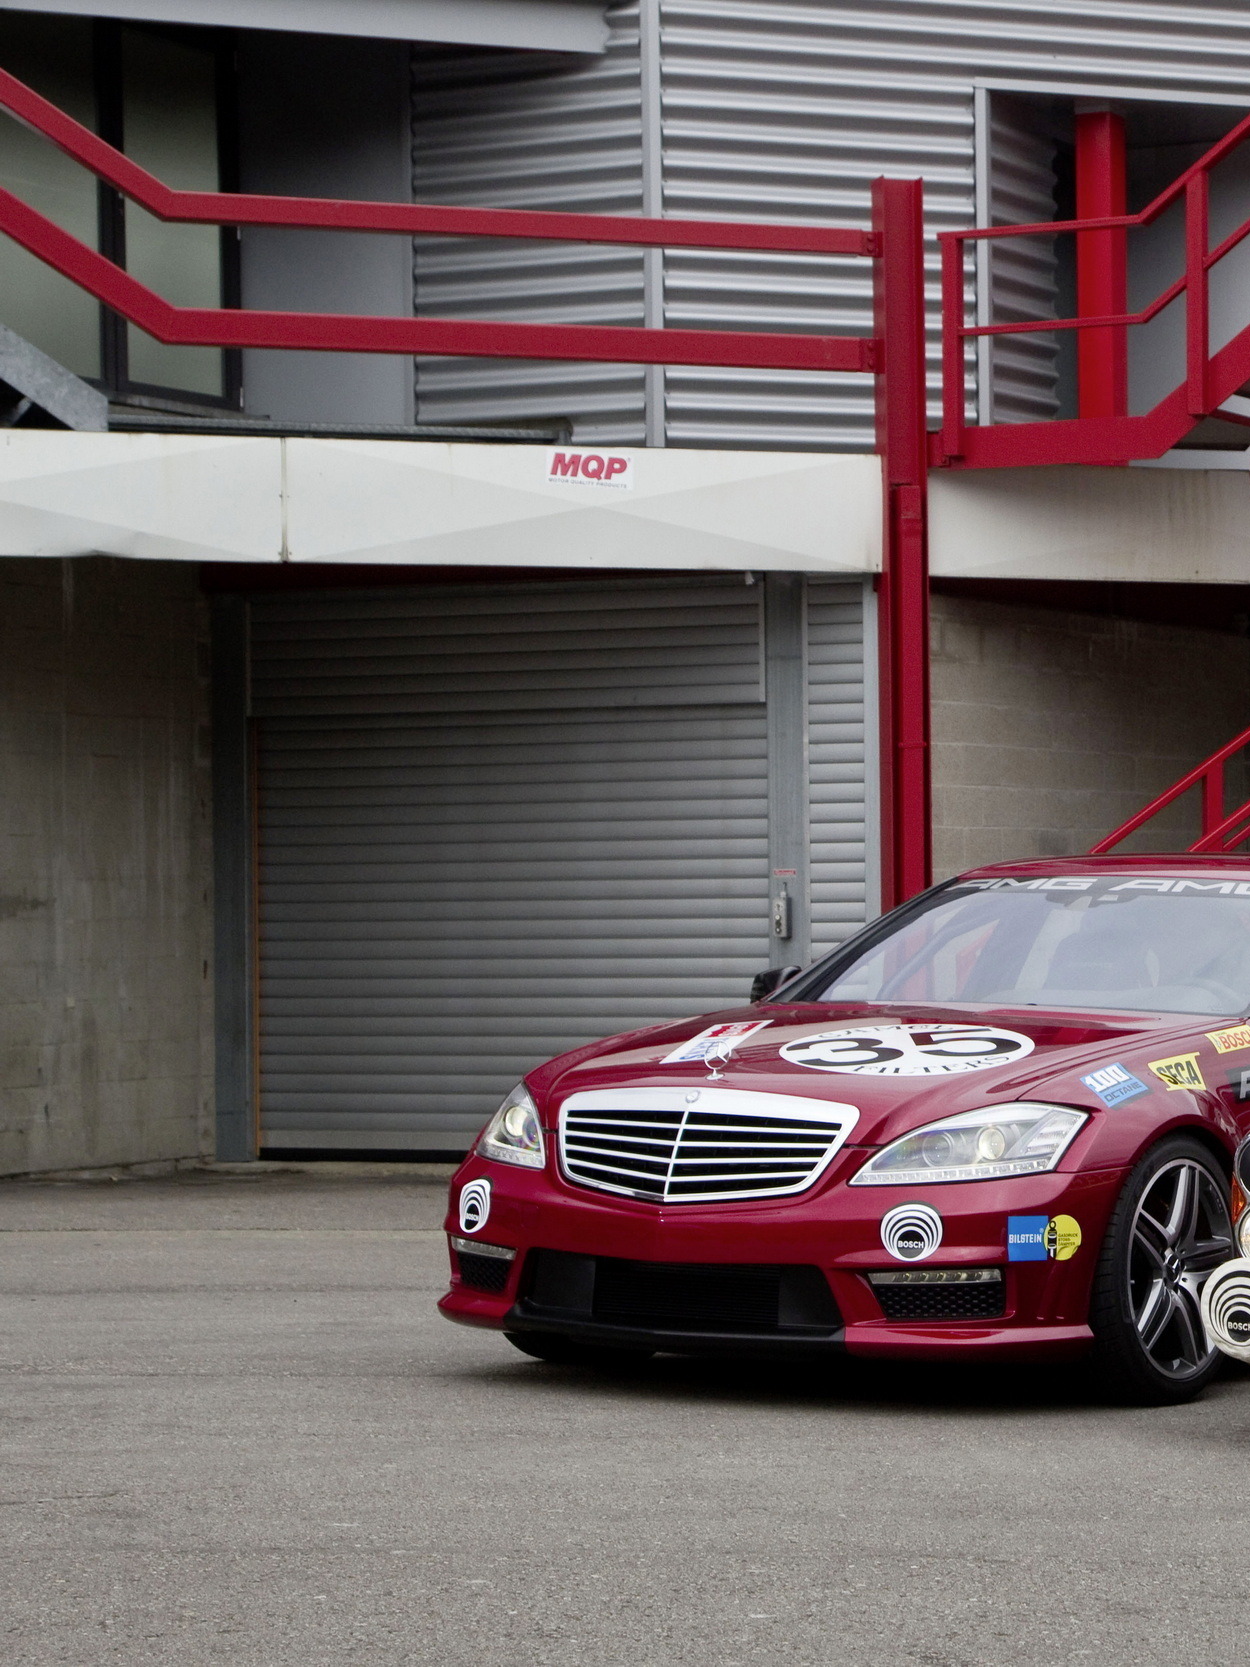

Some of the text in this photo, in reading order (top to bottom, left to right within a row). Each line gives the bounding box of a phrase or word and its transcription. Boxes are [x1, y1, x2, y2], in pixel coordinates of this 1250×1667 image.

[550, 452, 628, 480] MQP
[946, 878, 1099, 891] AMG
[786, 1028, 1022, 1067] 35
[853, 1055, 1010, 1074] FILTERS
[1156, 1060, 1202, 1086] SECA
[1084, 1064, 1131, 1093] 100
[1103, 1081, 1143, 1103] OCTANE
[897, 1240, 925, 1249] BOSCH
[1008, 1233, 1042, 1244] BILSTEIN
